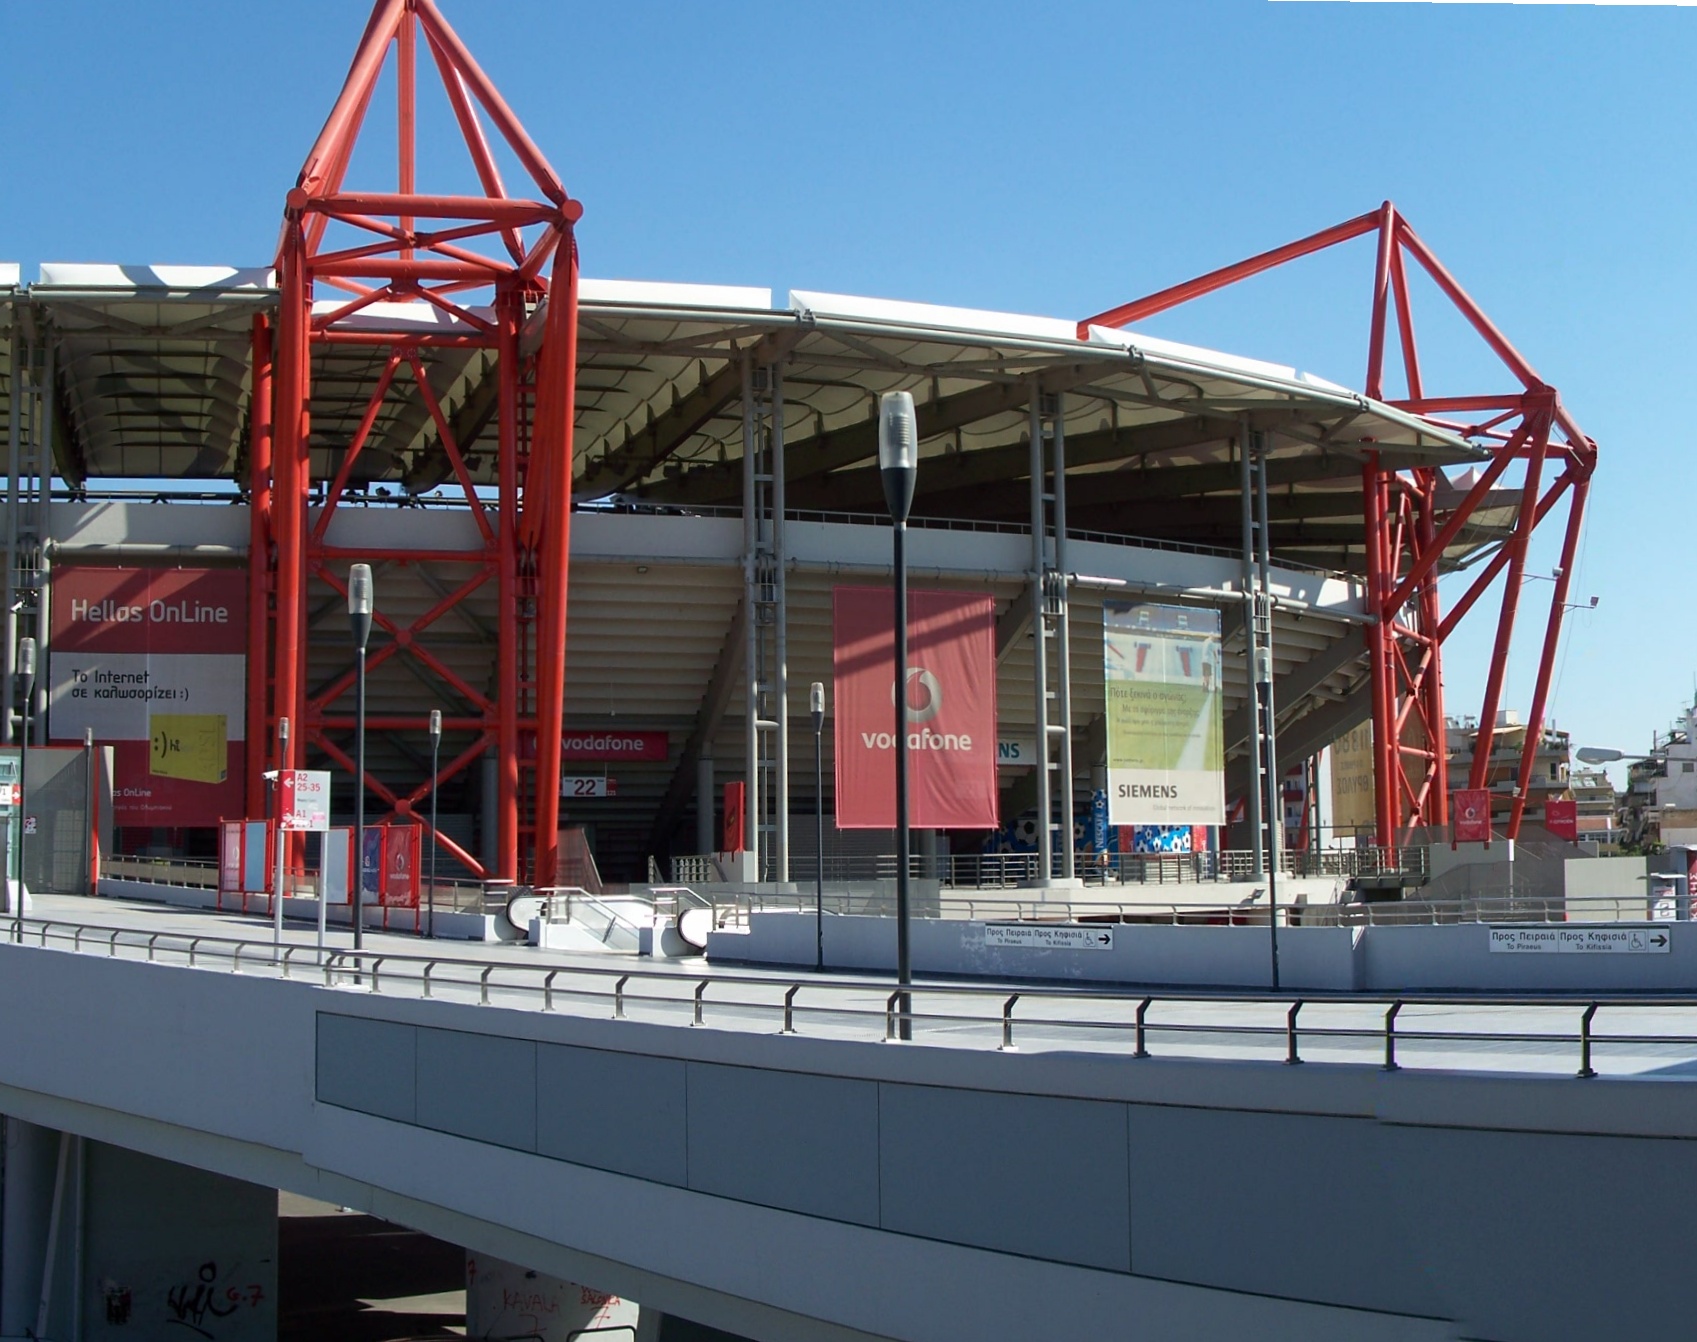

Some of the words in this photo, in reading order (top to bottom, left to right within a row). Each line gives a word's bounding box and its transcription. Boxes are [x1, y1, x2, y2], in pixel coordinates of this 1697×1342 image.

[72, 598, 142, 622] Hellas
[150, 600, 228, 622] OnLine
[95, 670, 149, 684] Internet
[72, 688, 88, 698] σε
[94, 686, 176, 702] καλωσορίζει
[562, 735, 644, 750] vodafone
[862, 728, 972, 750] voafone
[297, 773, 308, 781] A2
[124, 788, 152, 797] OnLine
[297, 783, 320, 792] 25-35
[574, 779, 596, 796] 22
[1118, 784, 1178, 798] SIEMENS
[1034, 930, 1051, 938] Προς
[1054, 930, 1082, 938] Κηφισιά
[1492, 932, 1515, 942] Προς
[1519, 932, 1556, 942] Πειραιά
[1560, 932, 1583, 942] Προς
[1588, 932, 1627, 942] Κηφισιά
[504, 1288, 562, 1314] KAVALA
